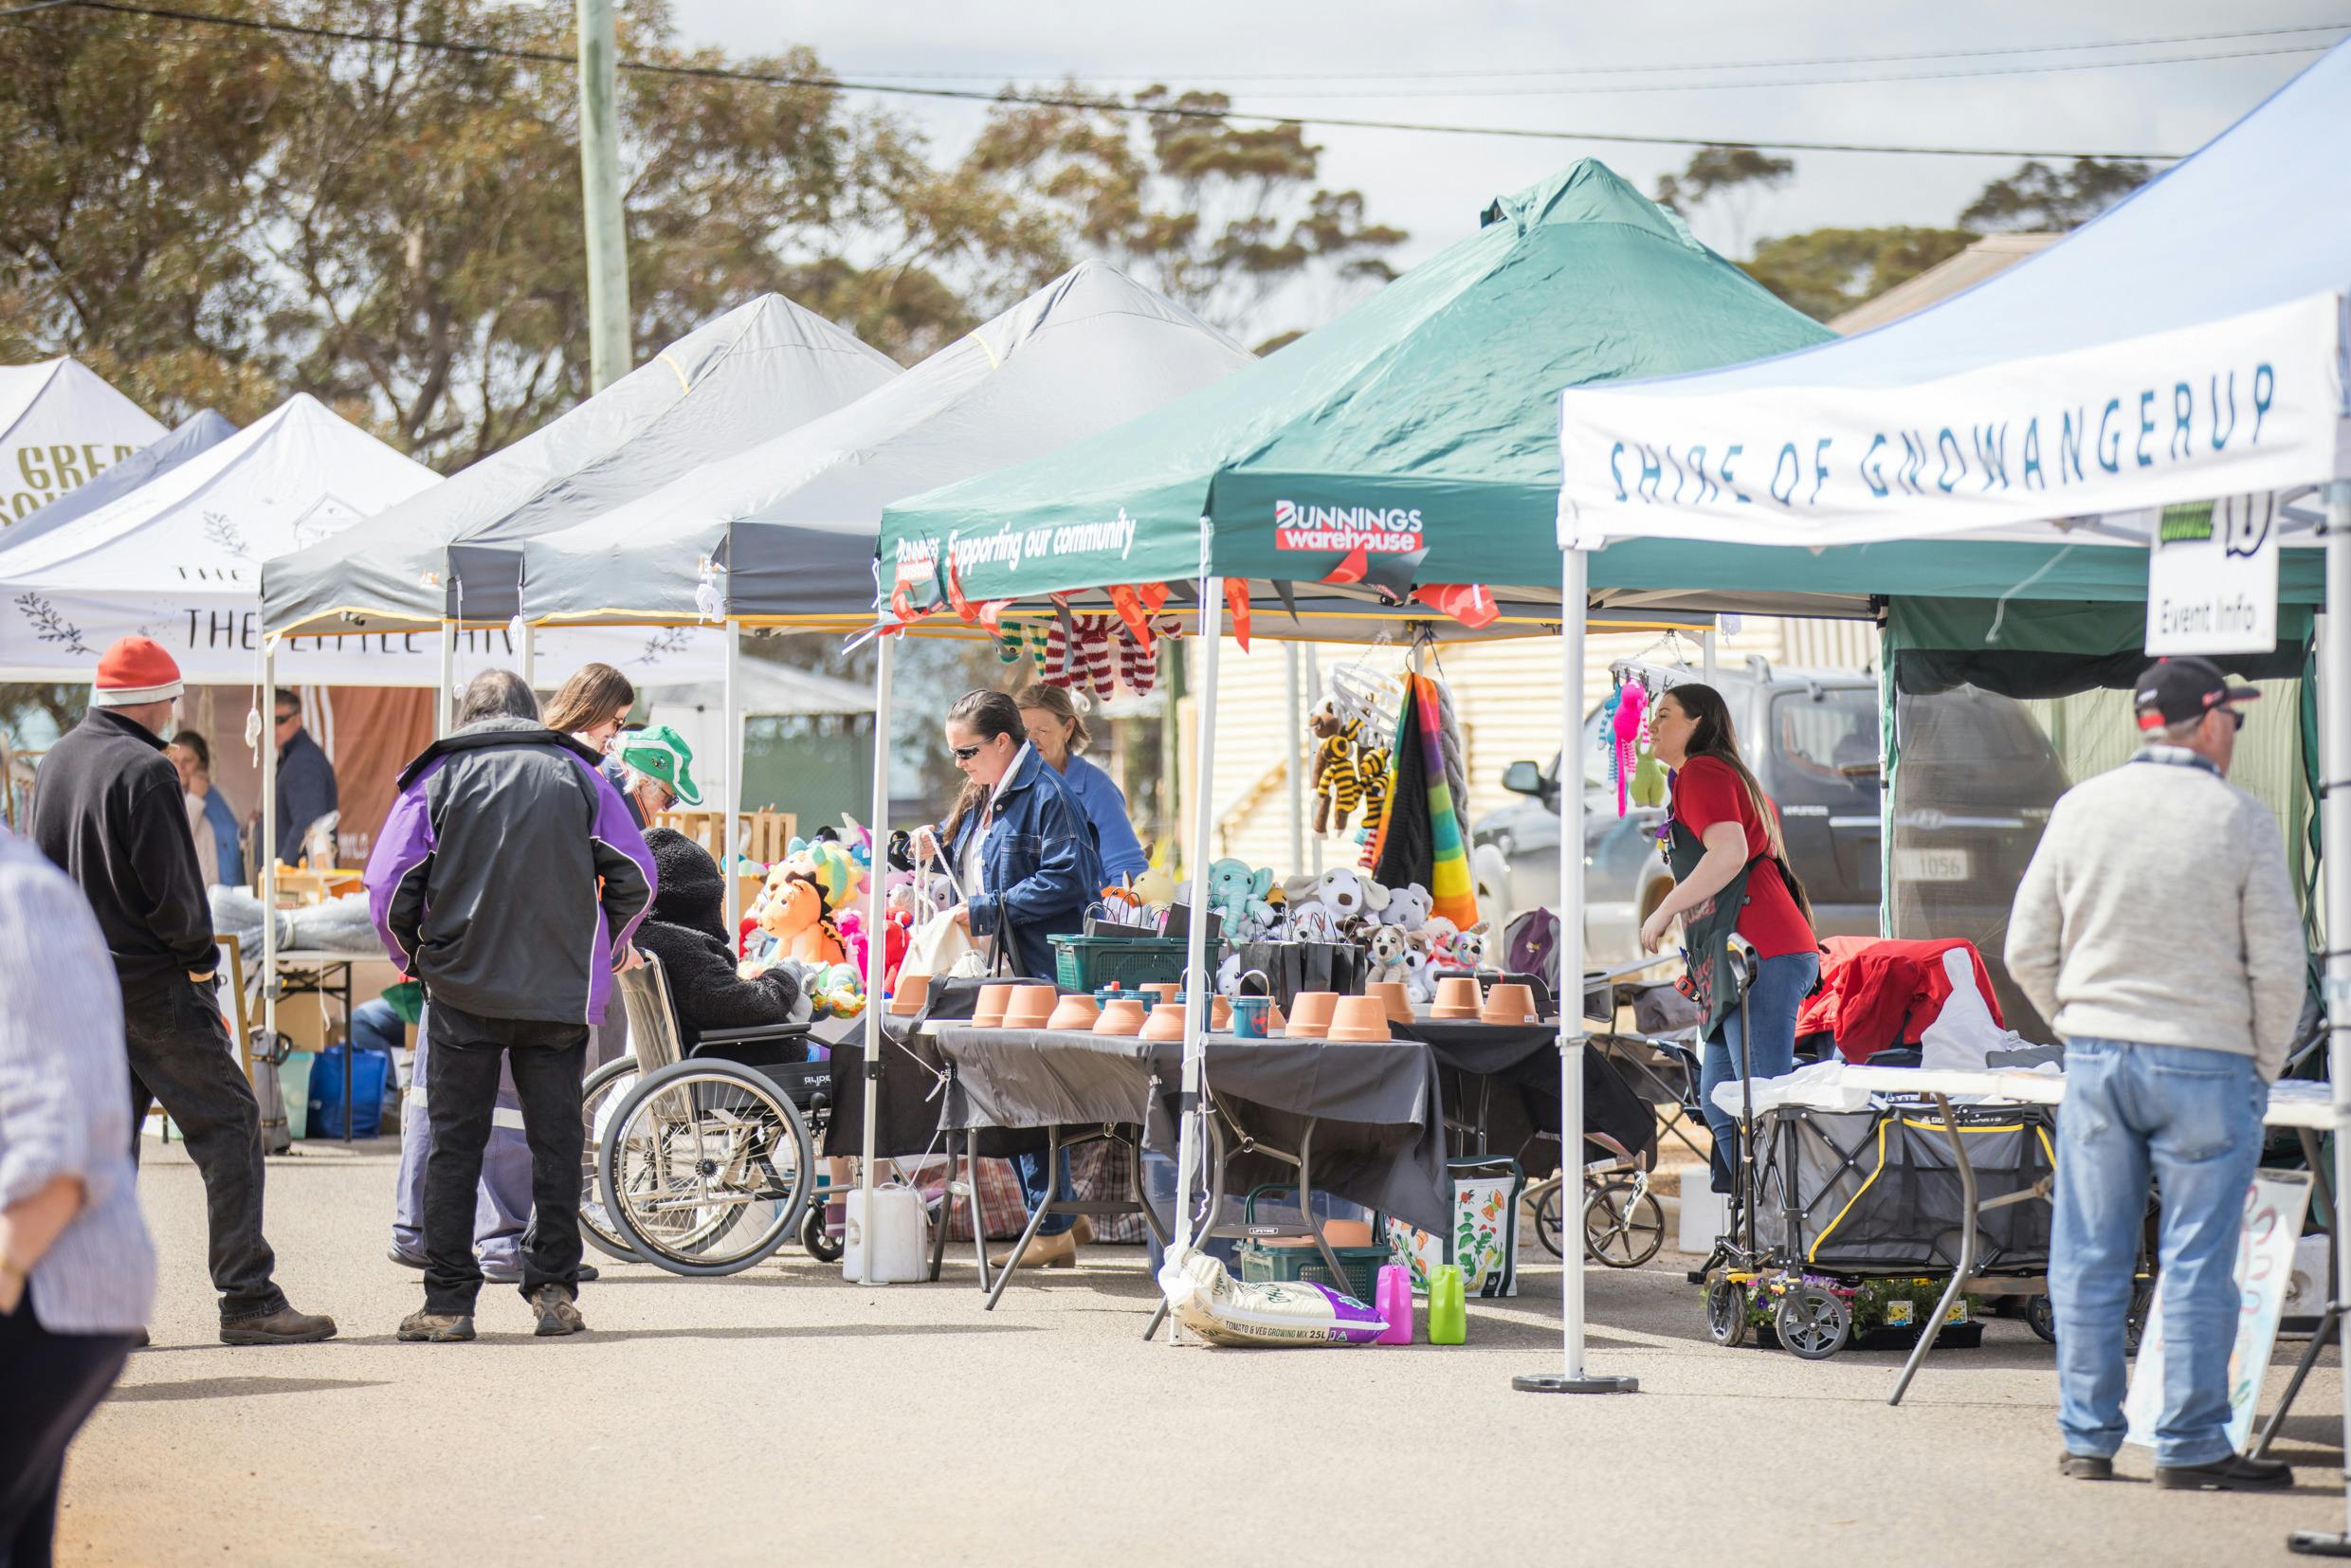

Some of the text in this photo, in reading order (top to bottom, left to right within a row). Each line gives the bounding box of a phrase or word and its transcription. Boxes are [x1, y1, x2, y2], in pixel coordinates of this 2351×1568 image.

[1611, 363, 2273, 507] SHIRE OF GNOWANGERUP
[17, 444, 147, 490] GRE
[1275, 500, 1423, 533] BUNNINGS
[944, 506, 1138, 576] Supporting our community
[1285, 524, 1416, 552] warehouse
[184, 610, 257, 650] THE
[2161, 593, 2255, 634] Event Info
[1920, 856, 1961, 877] 1056
[1226, 1320, 1249, 1335] TOMATO
[1255, 1326, 1267, 1336] VEG
[1267, 1327, 1296, 1339] GROWING
[1309, 1330, 1326, 1340] 25L
